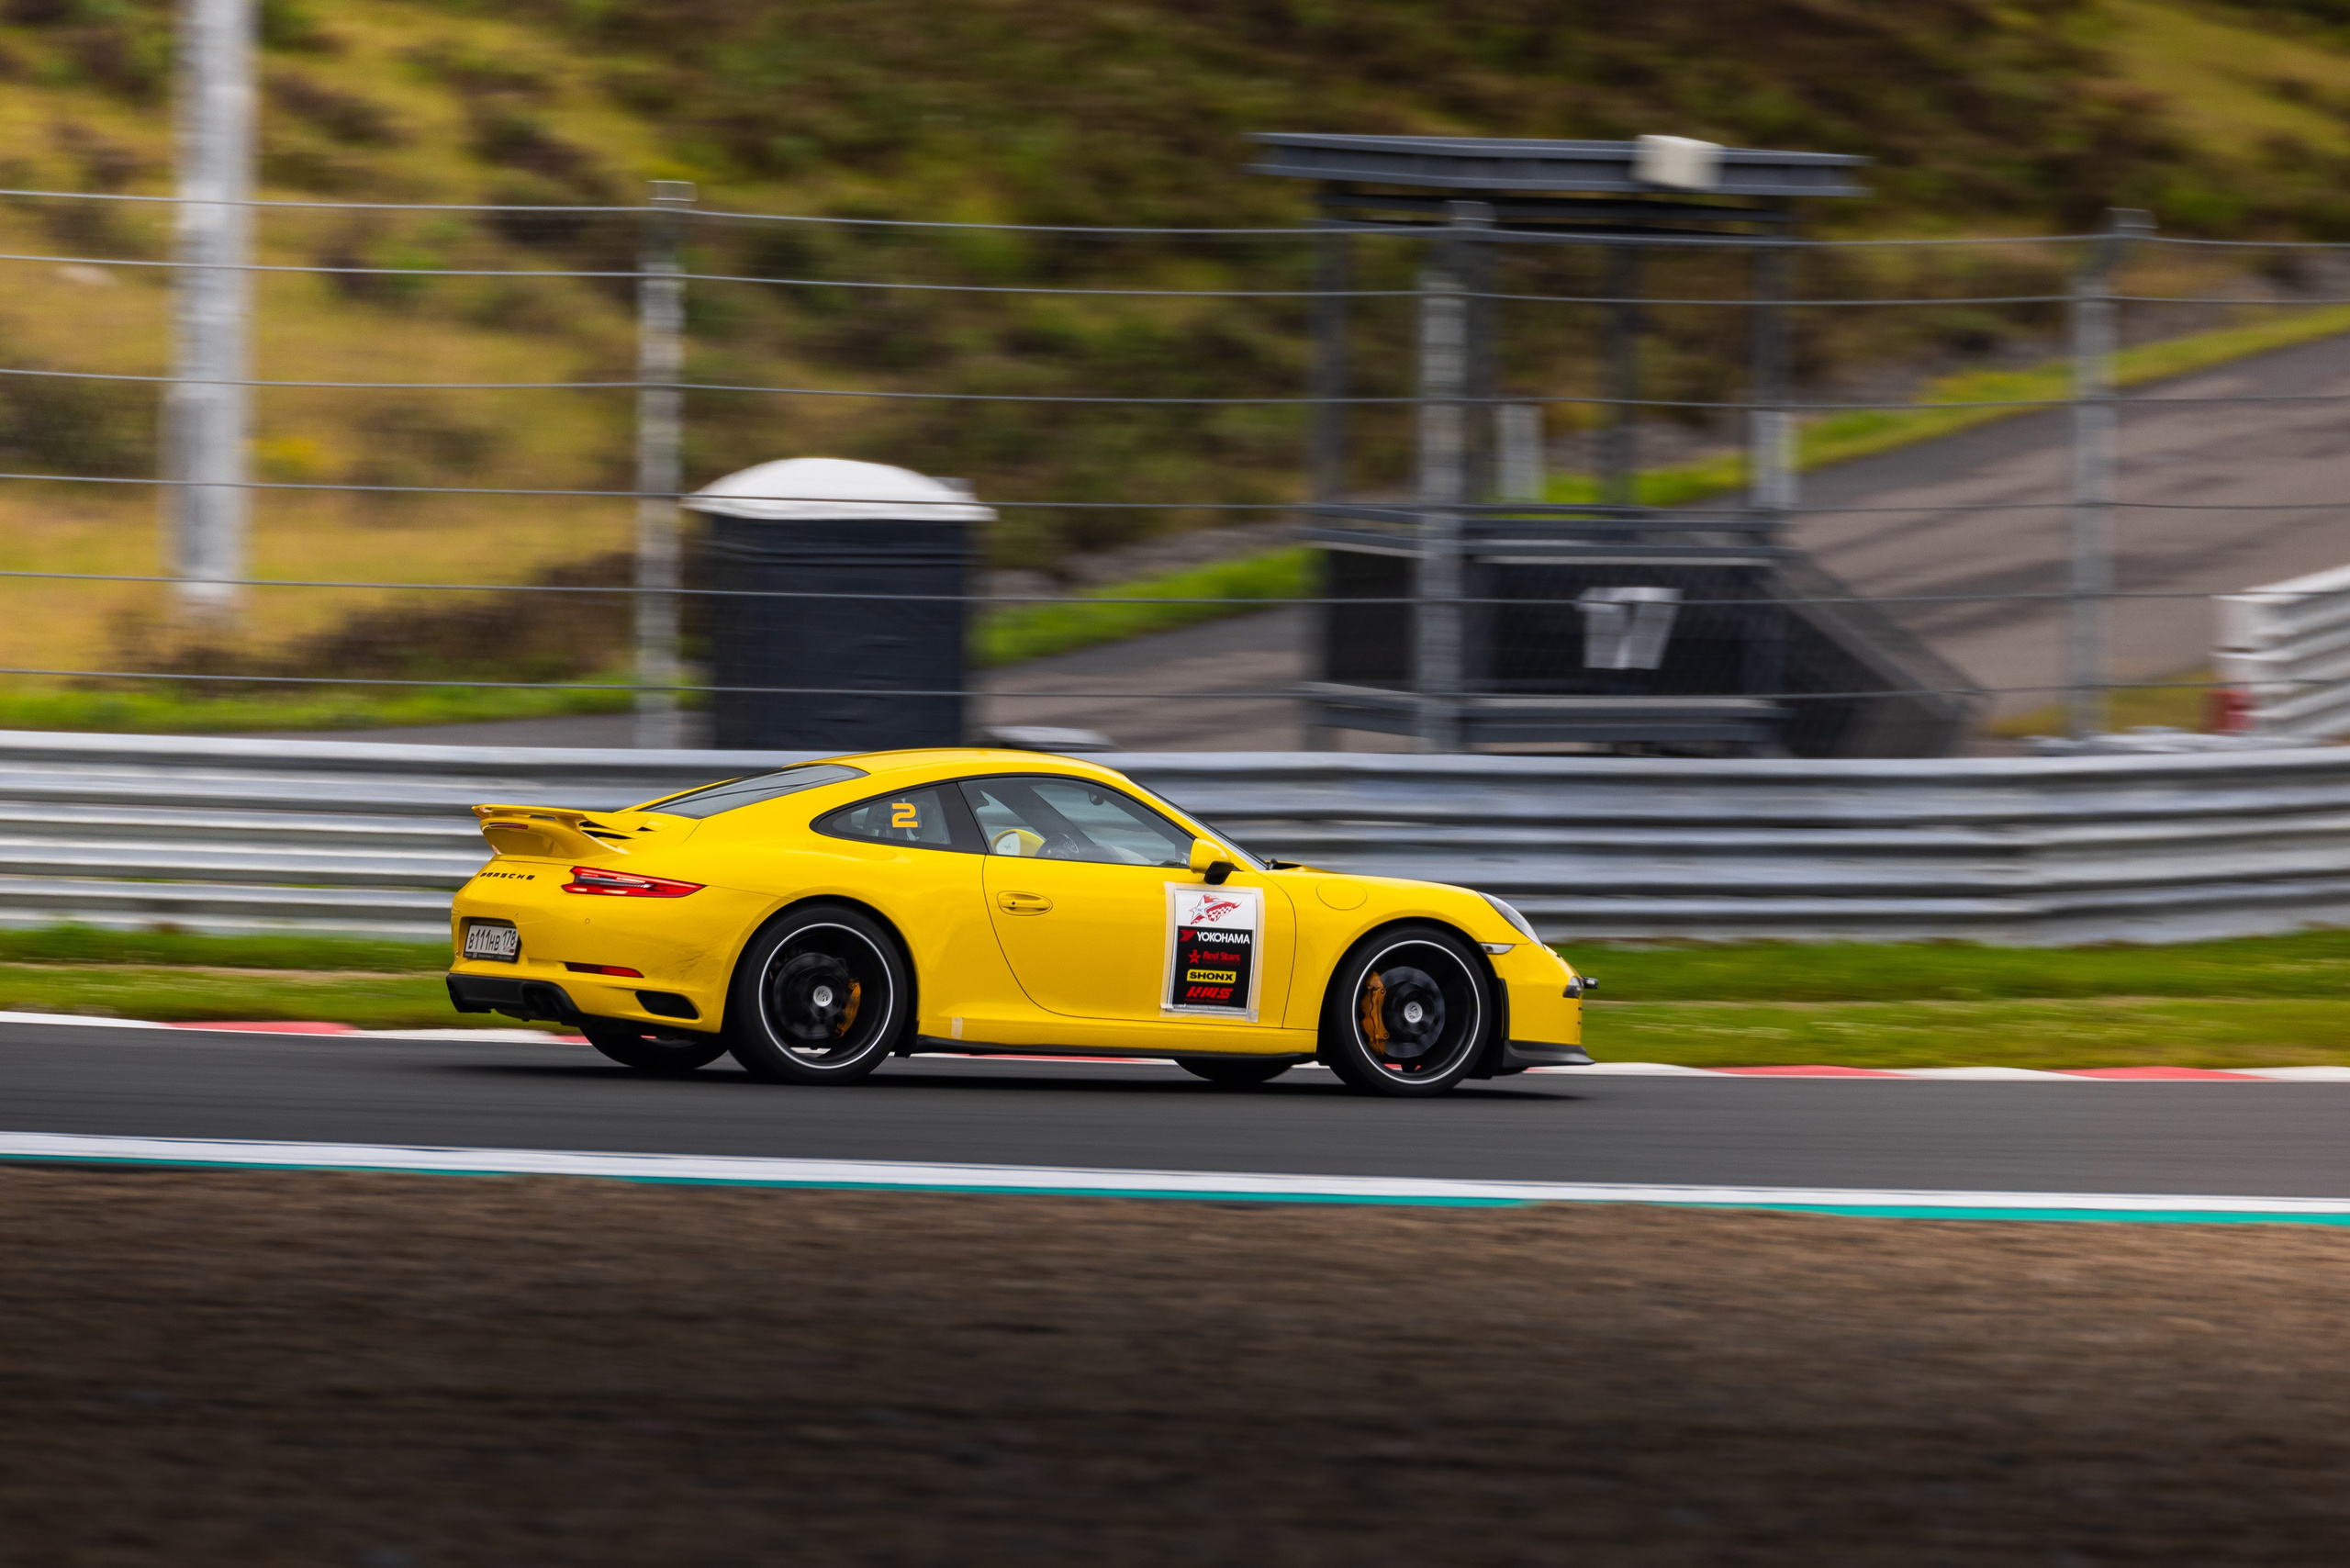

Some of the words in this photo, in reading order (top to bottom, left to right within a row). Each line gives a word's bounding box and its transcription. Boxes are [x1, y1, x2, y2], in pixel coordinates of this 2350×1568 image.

[891, 802, 918, 828] 2
[503, 930, 517, 946] 178
[1196, 931, 1250, 944] YOKOHAMA
[1203, 950, 1219, 960] Red
[1220, 952, 1240, 961] Stars
[1189, 971, 1234, 981] SHONX
